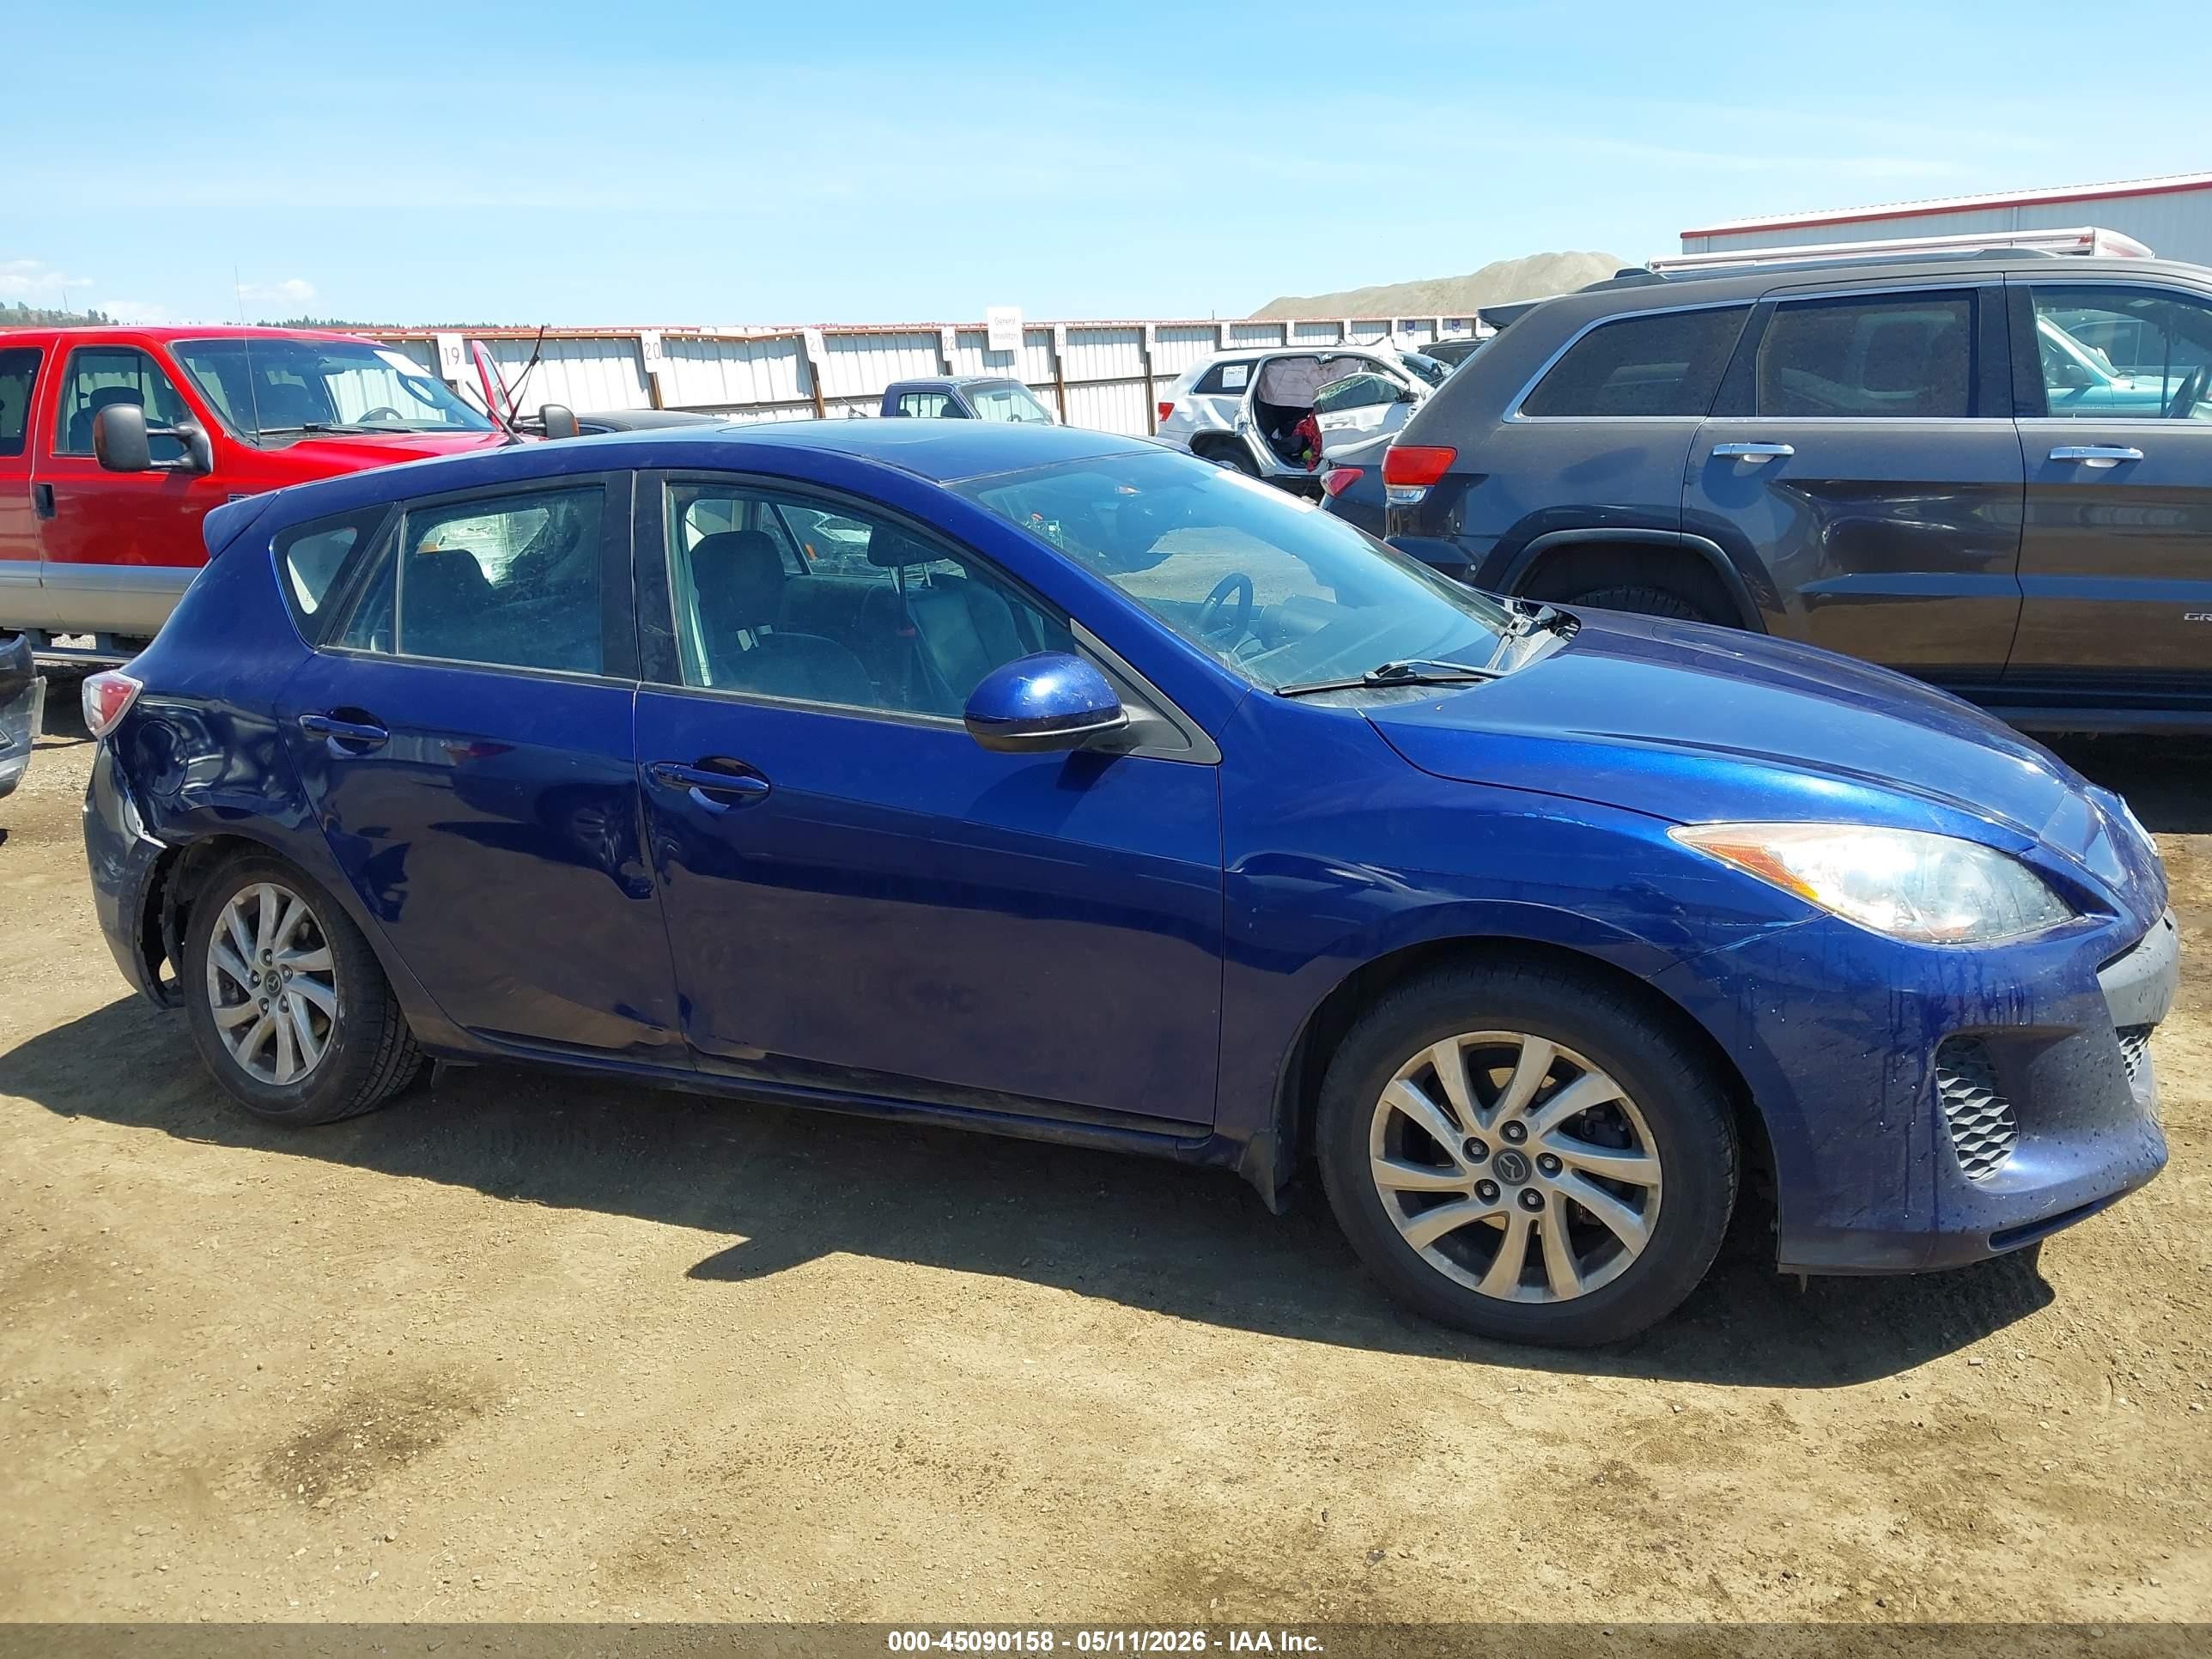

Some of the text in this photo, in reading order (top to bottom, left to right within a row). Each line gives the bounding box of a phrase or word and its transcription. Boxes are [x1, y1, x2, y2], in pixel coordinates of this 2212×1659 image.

[643, 341, 661, 361] 20
[943, 336, 955, 351] 22
[443, 346, 460, 366] 19
